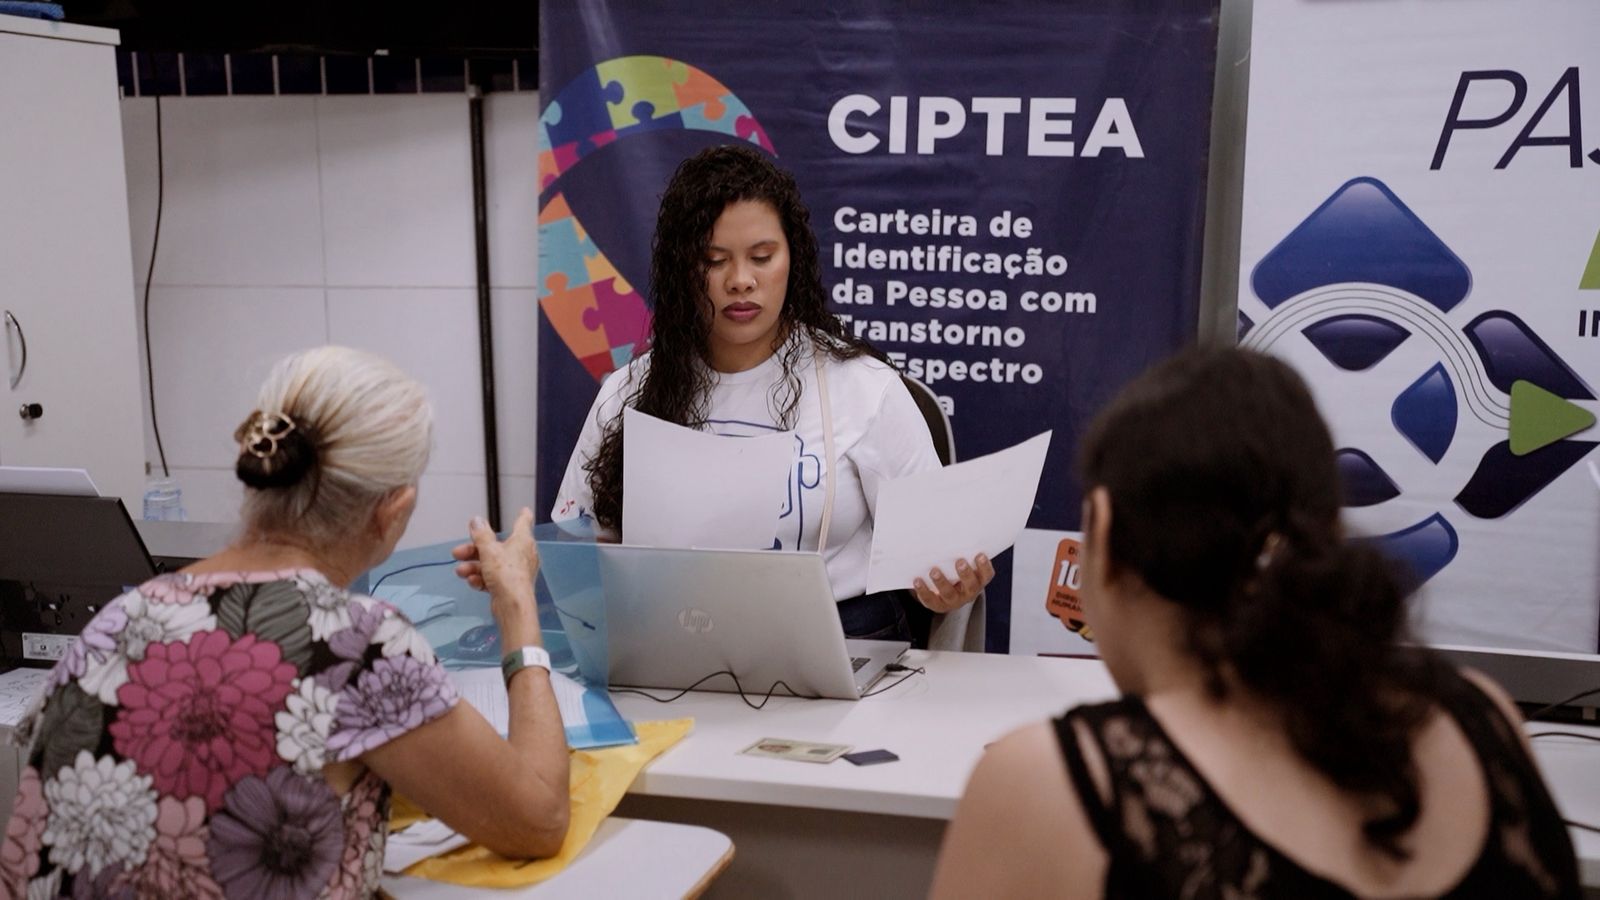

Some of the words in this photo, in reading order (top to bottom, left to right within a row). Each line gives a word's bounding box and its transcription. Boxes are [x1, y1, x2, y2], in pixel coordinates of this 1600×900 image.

[828, 94, 1145, 158] CIPTEA
[1430, 66, 1600, 170] PA
[834, 207, 977, 236] Carteira
[990, 211, 1033, 238] de
[833, 243, 1068, 279] Identificação
[832, 278, 874, 305] da
[886, 280, 1007, 310] Pessoa
[1020, 291, 1097, 313] com
